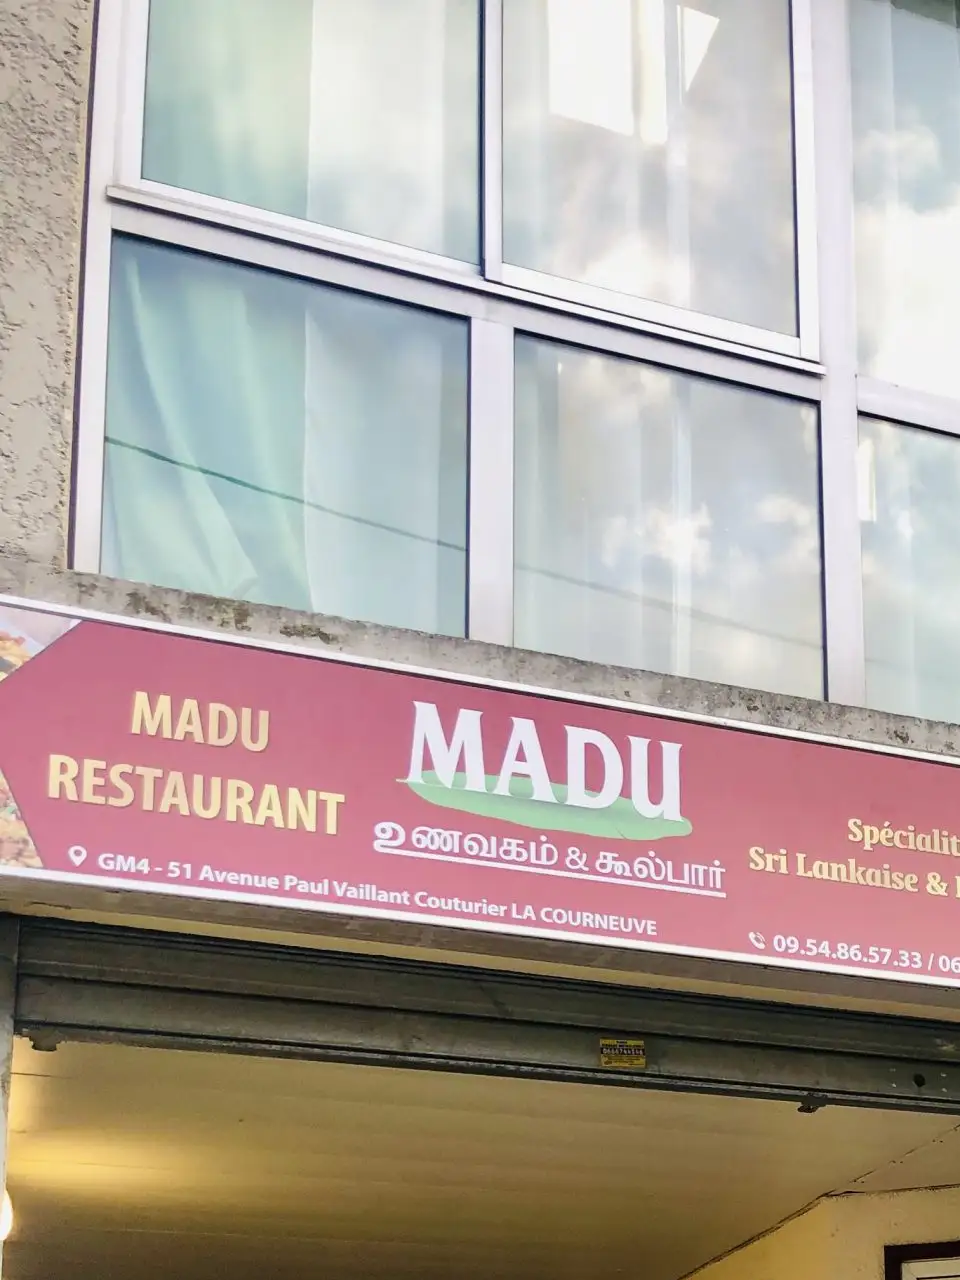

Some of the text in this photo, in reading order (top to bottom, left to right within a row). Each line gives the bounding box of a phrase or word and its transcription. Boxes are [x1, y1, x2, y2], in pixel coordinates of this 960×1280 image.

[130, 691, 271, 752] MADU
[47, 754, 345, 835] RESTAURANT
[409, 700, 684, 823] MADU
[373, 821, 726, 889] உணவகம் & கூல்பார்
[749, 846, 789, 875] Sri
[796, 852, 919, 893] Lankaise
[925, 871, 949, 897] &
[98, 853, 150, 874] GM4
[167, 861, 192, 879] 51
[199, 865, 280, 889] Avenue
[284, 875, 329, 895] Paul
[334, 880, 410, 906] Vaillant
[414, 891, 507, 917] Couturier
[511, 903, 536, 920] LA
[540, 907, 657, 936] COURNEUVE
[773, 934, 923, 970] 09.54.86.57.33
[927, 955, 934, 972] /
